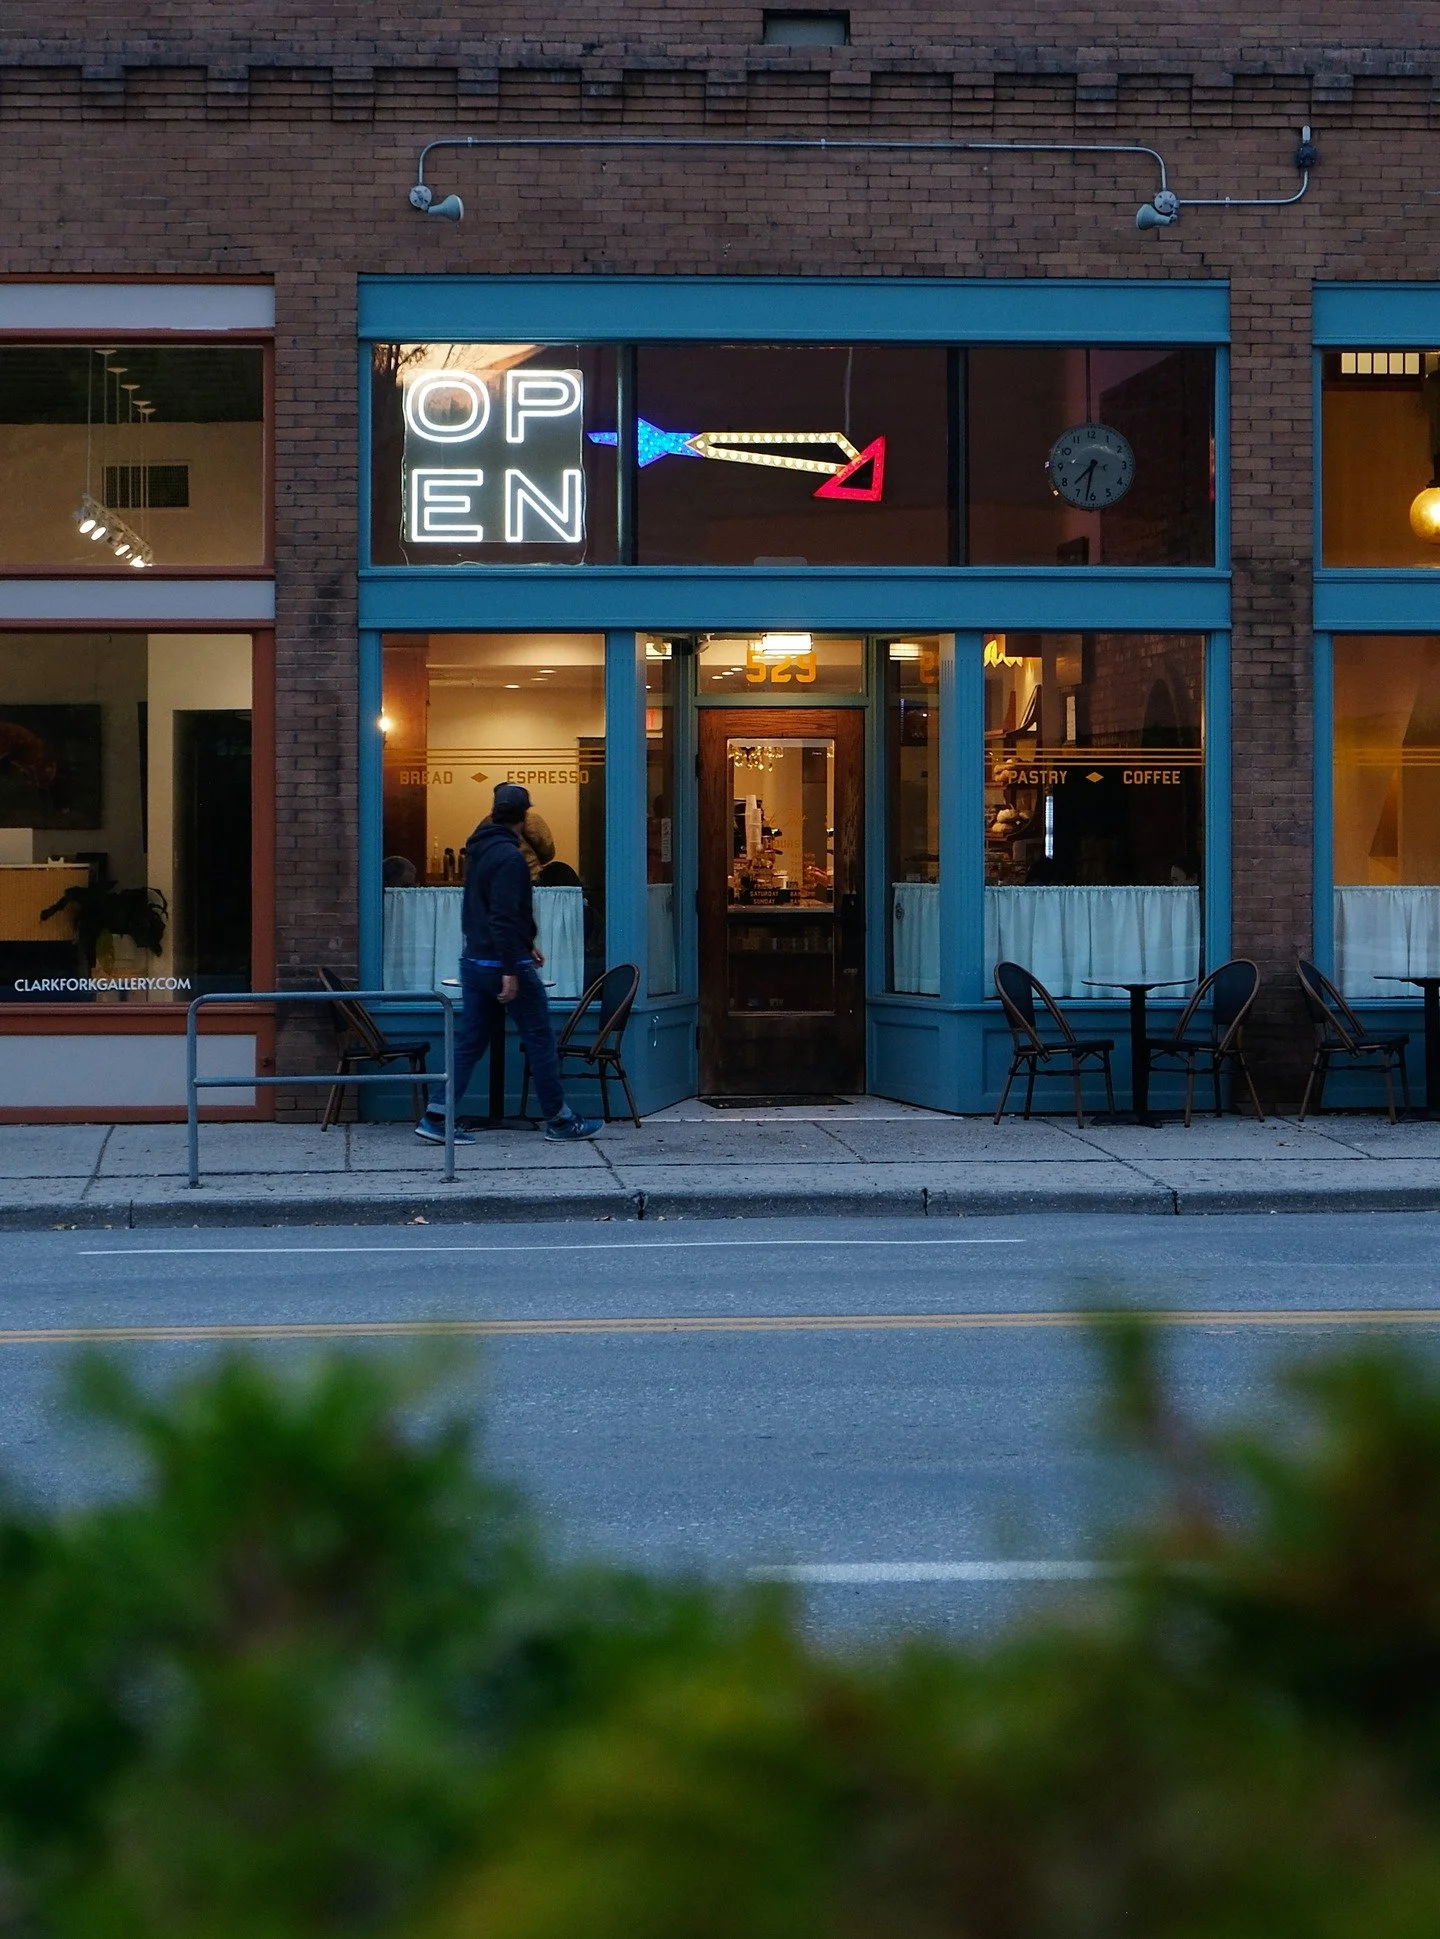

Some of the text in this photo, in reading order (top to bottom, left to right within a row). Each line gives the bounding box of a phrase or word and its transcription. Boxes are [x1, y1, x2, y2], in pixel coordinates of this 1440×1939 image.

[1087, 430, 1096, 439] 12
[1106, 435, 1110, 443] 1
[1073, 436, 1080, 444] 11
[1061, 447, 1072, 456] 10
[1117, 445, 1122, 453] 2
[1058, 463, 1063, 472] 9
[1122, 461, 1127, 470] 3
[1062, 477, 1068, 487] 8
[1117, 477, 1123, 485] 4
[1076, 489, 1081, 497] 7
[1089, 491, 1096, 501] 6
[1105, 488, 1111, 497] 5
[745, 649, 817, 683] 529
[400, 770, 590, 785] BREAD ESPRESSO
[1009, 770, 1181, 785] PASTRY COFFEE
[14, 977, 191, 992] CLARKFORKGALLERY.COM
